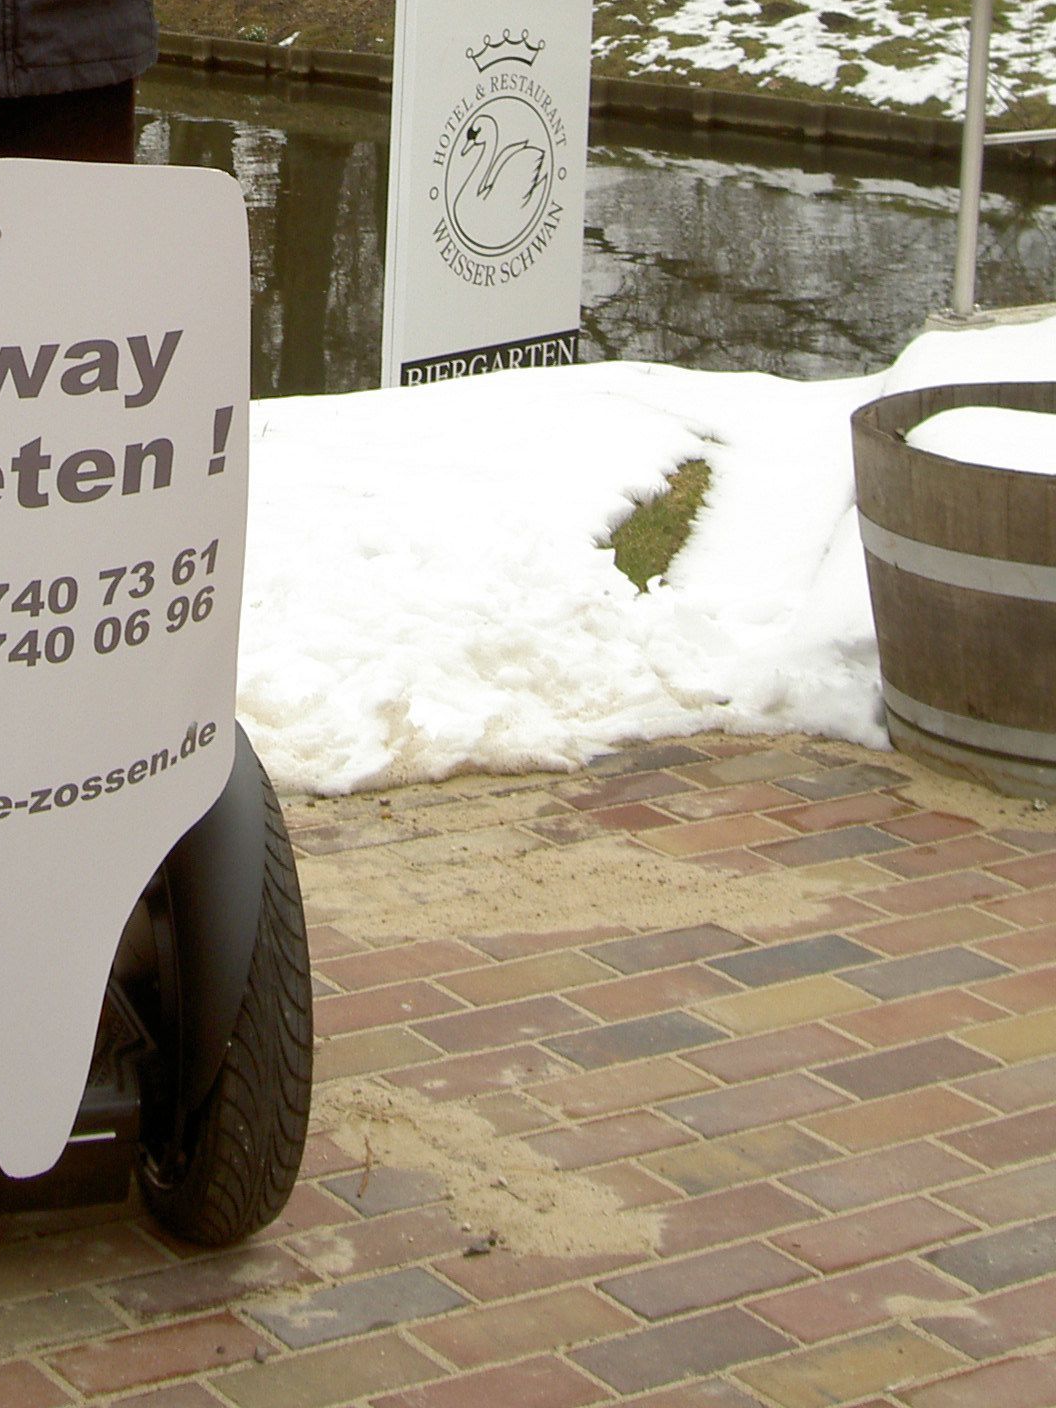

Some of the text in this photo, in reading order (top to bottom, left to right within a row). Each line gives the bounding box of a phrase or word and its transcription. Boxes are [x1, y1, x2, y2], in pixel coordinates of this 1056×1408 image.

[433, 73, 567, 166] HOTEL & RESTAURANT
[432, 201, 564, 287] WEISSER SCHWAN
[99, 561, 155, 606] 73
[172, 540, 220, 586] 61
[94, 610, 150, 654] 06
[166, 587, 214, 633] 96
